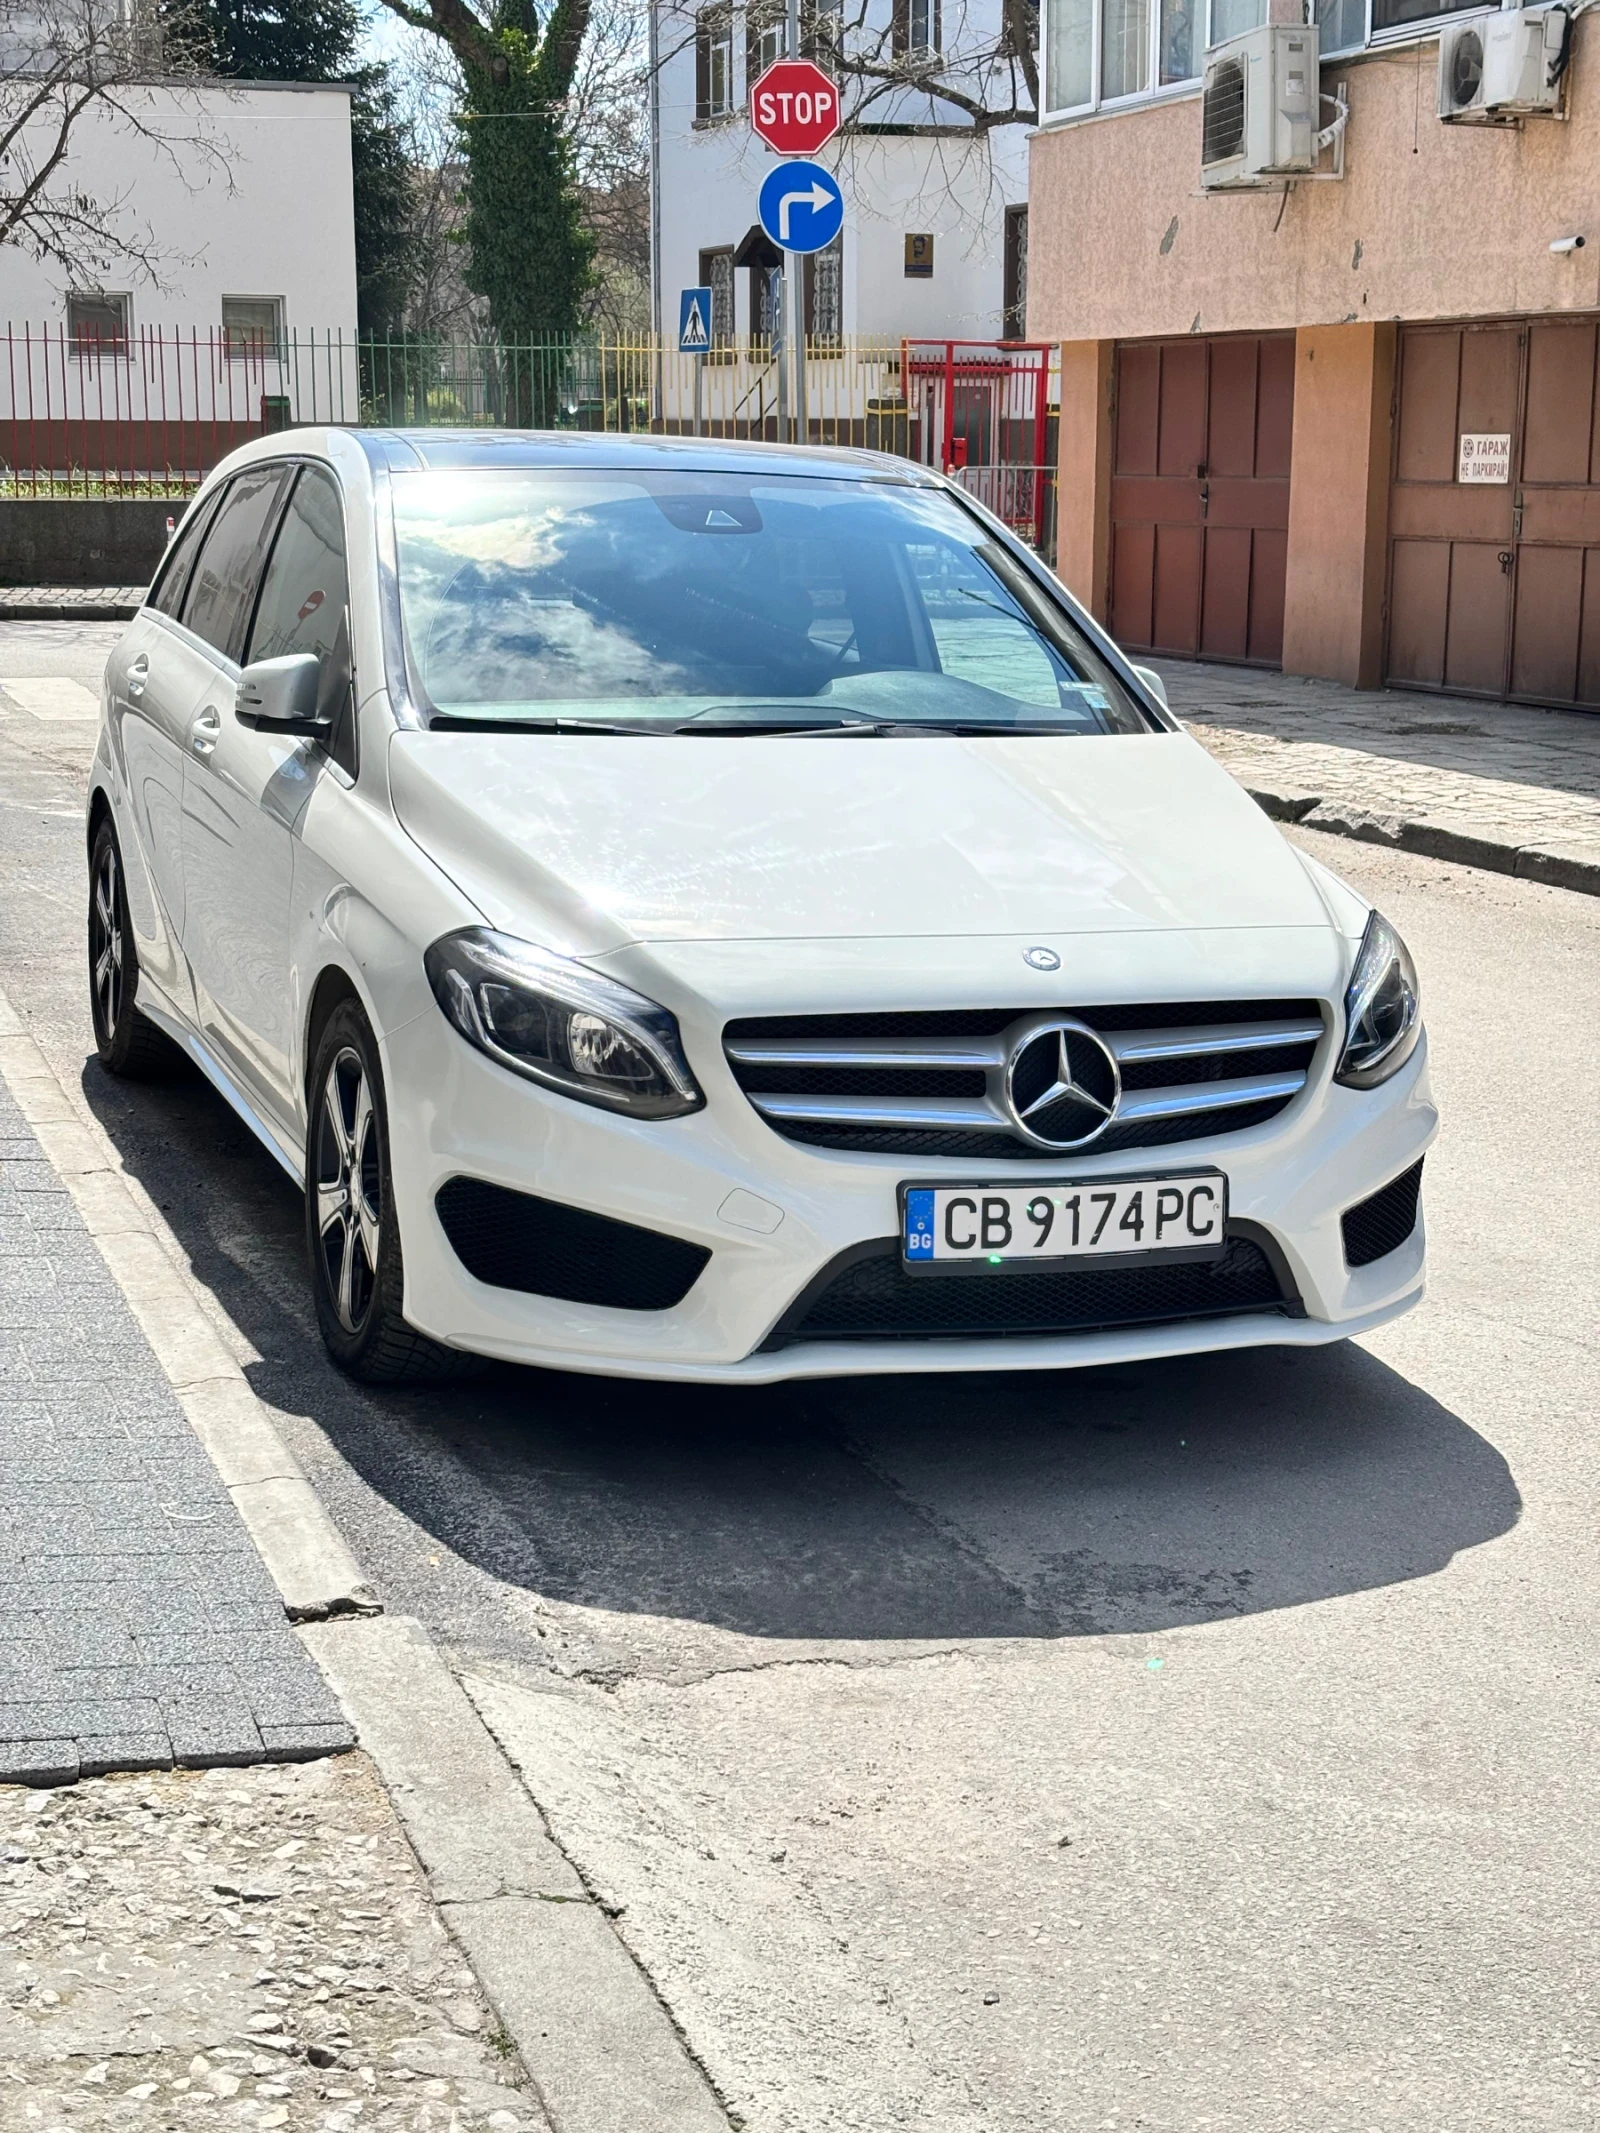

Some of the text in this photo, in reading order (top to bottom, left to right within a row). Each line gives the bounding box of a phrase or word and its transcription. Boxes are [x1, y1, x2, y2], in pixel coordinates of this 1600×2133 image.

[759, 92, 832, 125] STOP
[1477, 440, 1509, 456] ГАРАЖ
[1461, 463, 1469, 476] НЕ
[944, 1185, 1215, 1250] CB 9174 PC
[909, 1233, 932, 1249] BG
